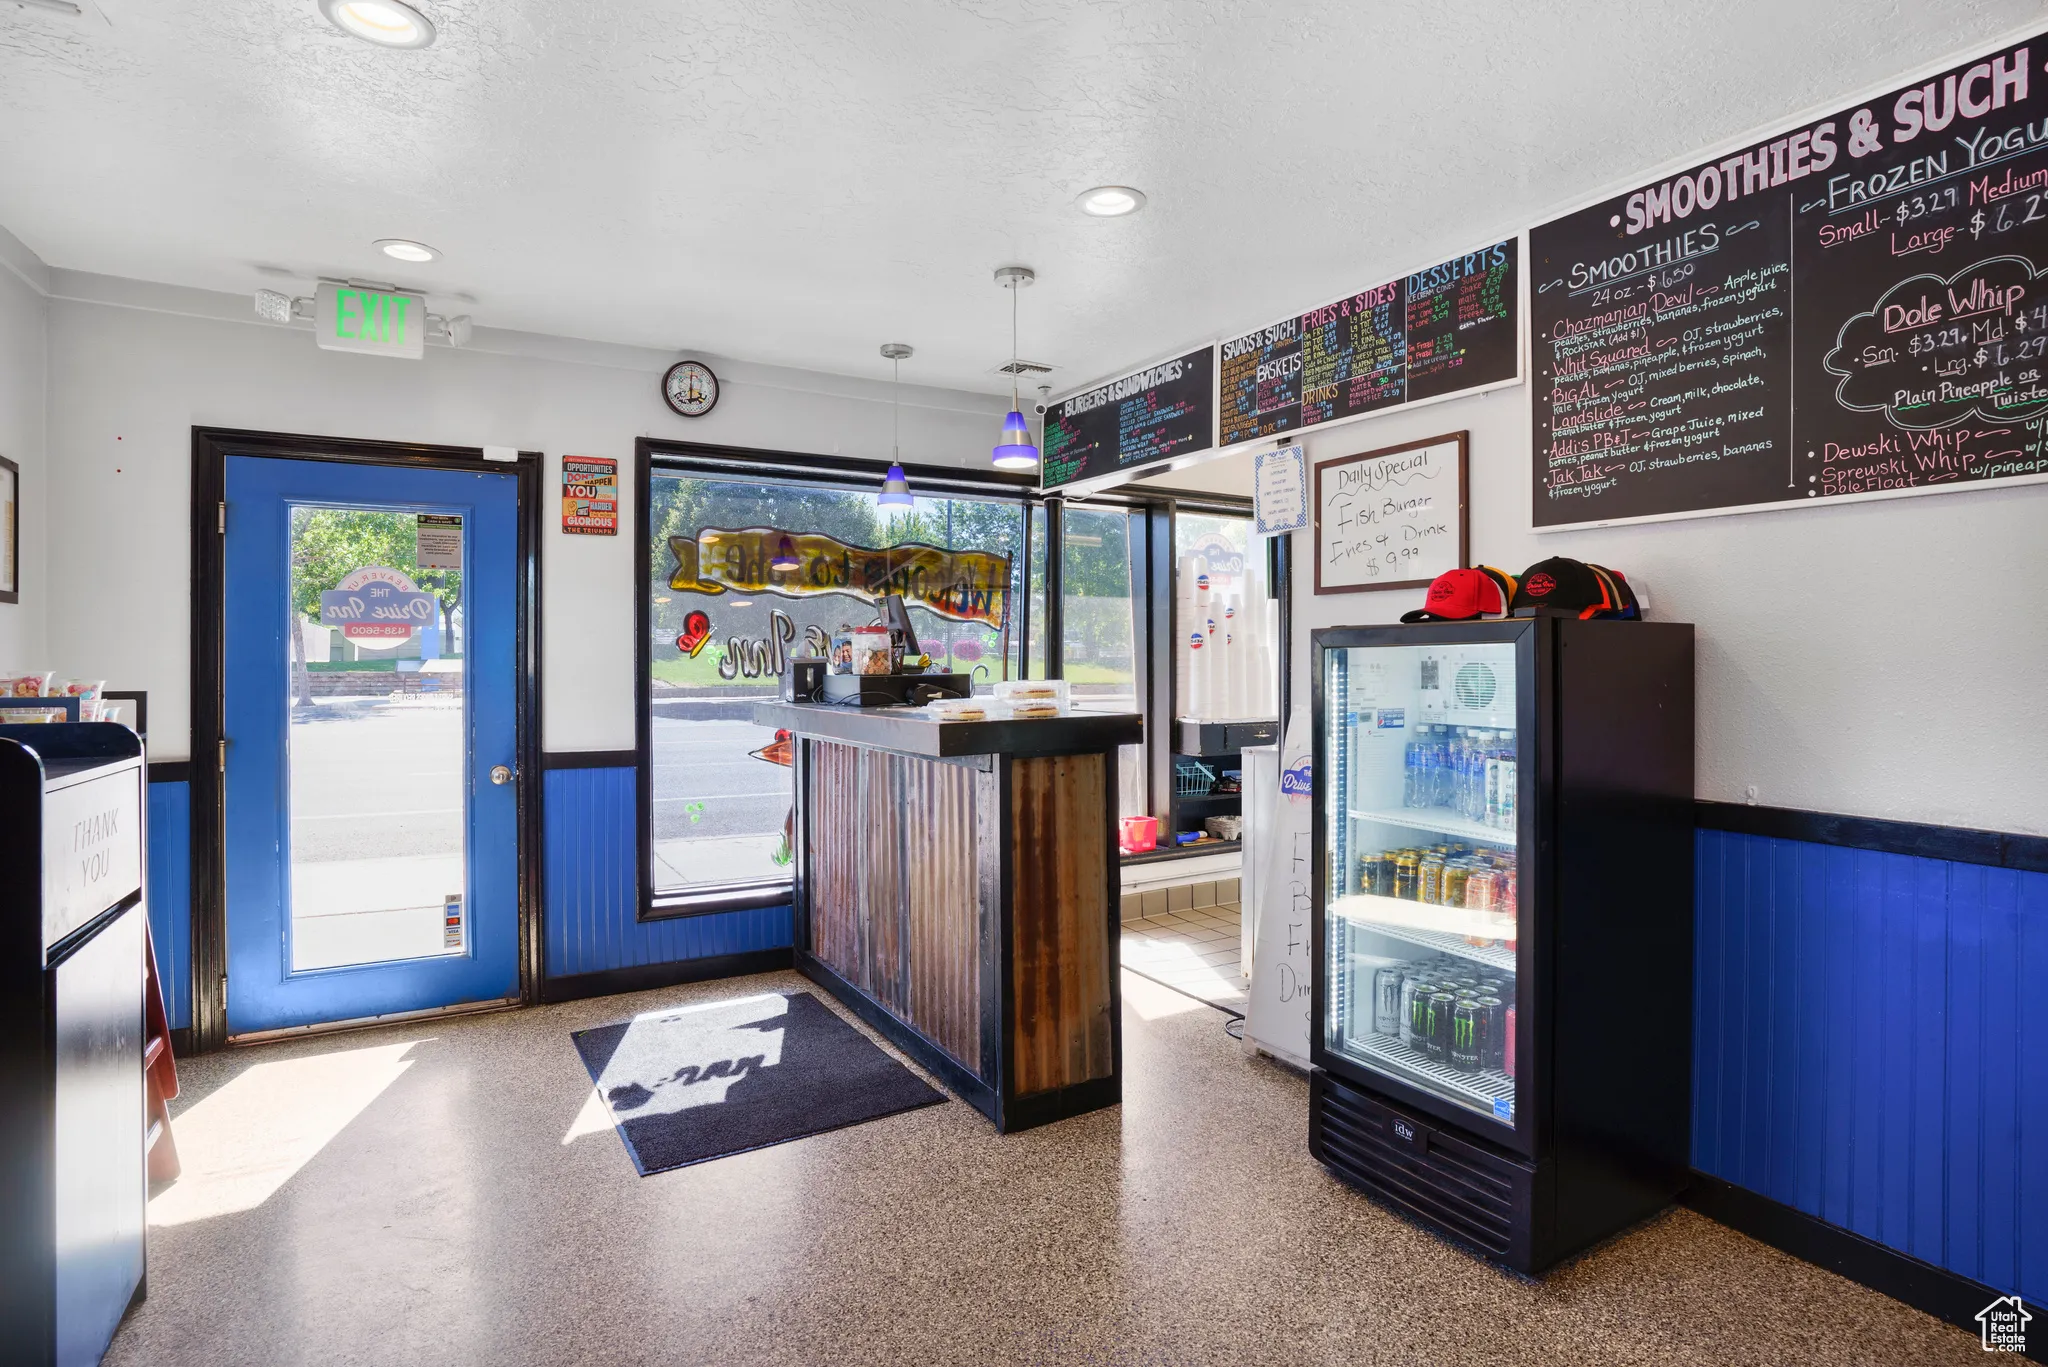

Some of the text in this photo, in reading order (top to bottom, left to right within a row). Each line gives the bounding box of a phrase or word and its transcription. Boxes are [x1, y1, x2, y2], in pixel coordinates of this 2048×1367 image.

[1624, 48, 2030, 235] SMOOTHIES & SUCH
[1828, 150, 1947, 209] FROZEN
[1969, 169, 2048, 206] Medium
[1409, 241, 1507, 295] DESSERTS
[1568, 222, 1720, 289] SMOOTHIES
[1436, 281, 1455, 293] CONES
[1553, 261, 1789, 339] Chazmanian Devil Apple juice,
[1592, 289, 1610, 307] 24
[1884, 278, 2025, 333] Dole Whip
[337, 289, 411, 346] EXIT
[1303, 303, 1338, 332] FRIES
[1341, 300, 1350, 317] &
[1355, 281, 1397, 313] SIDES
[1592, 315, 1655, 339] strawberries,
[1656, 302, 1702, 323] bananas,
[1702, 294, 1737, 312] frozen
[1737, 279, 1777, 304] yogurt
[1256, 332, 1263, 347] &
[1265, 319, 1296, 345] SUCH
[1552, 357, 1586, 377] Whit
[1590, 344, 1651, 370] Squared
[1705, 306, 1784, 335] strawberries,
[1593, 361, 1633, 377] bananas,
[1633, 349, 1679, 369] pineapple,
[1723, 324, 1764, 348] yogurt
[1608, 331, 1629, 347] (Add
[1257, 352, 1302, 383] BASKETS
[1551, 388, 1580, 405] BIG
[1582, 381, 1600, 399] AL
[1649, 366, 1677, 381] mixed
[1679, 356, 1720, 373] berries,
[1722, 347, 1767, 365] spinach,
[1065, 388, 1108, 418] BURGERS
[1115, 360, 1183, 400] SANDWICHES
[1303, 383, 1339, 406] DRINKS
[1551, 376, 1765, 431] Landslide Cream, milk, chocolate,
[1612, 385, 1644, 404] yogurt
[1892, 368, 2041, 408] Plain Pineapple OR
[1552, 426, 1580, 440] peanut
[1580, 421, 1606, 433] butter
[1649, 407, 1682, 423] yogurt
[1651, 424, 1687, 439] Grape
[1687, 417, 1725, 430] Juice,
[1728, 407, 1764, 422] mixed
[1547, 469, 1574, 488] Jak
[1575, 464, 1604, 485] Jak
[1649, 450, 1721, 470] strawberries,
[1723, 439, 1773, 457] bananas
[1580, 451, 1609, 464] peanut
[1611, 444, 1641, 457] butter
[1684, 428, 1720, 447] yogurt
[1823, 429, 1970, 463] Dewski Whip
[567, 463, 612, 473] OPPORTUNITIES
[567, 472, 595, 483] DON'T
[585, 477, 612, 486] HAPPEN
[1339, 451, 1428, 492] Daily Special
[1821, 449, 1975, 486] Sprewski Whip
[1823, 480, 1865, 496] Dole
[1866, 472, 1919, 491] Float
[567, 485, 596, 498] YOU
[1584, 477, 1617, 497] yogurt
[567, 517, 612, 526] GLORIOUS
[1338, 497, 1432, 535] Fish Burger
[1330, 540, 1372, 566] Fries
[1401, 523, 1447, 541] Drink
[1284, 774, 1311, 791] Drive
[73, 807, 119, 853] THANK
[82, 848, 110, 888] YOU
